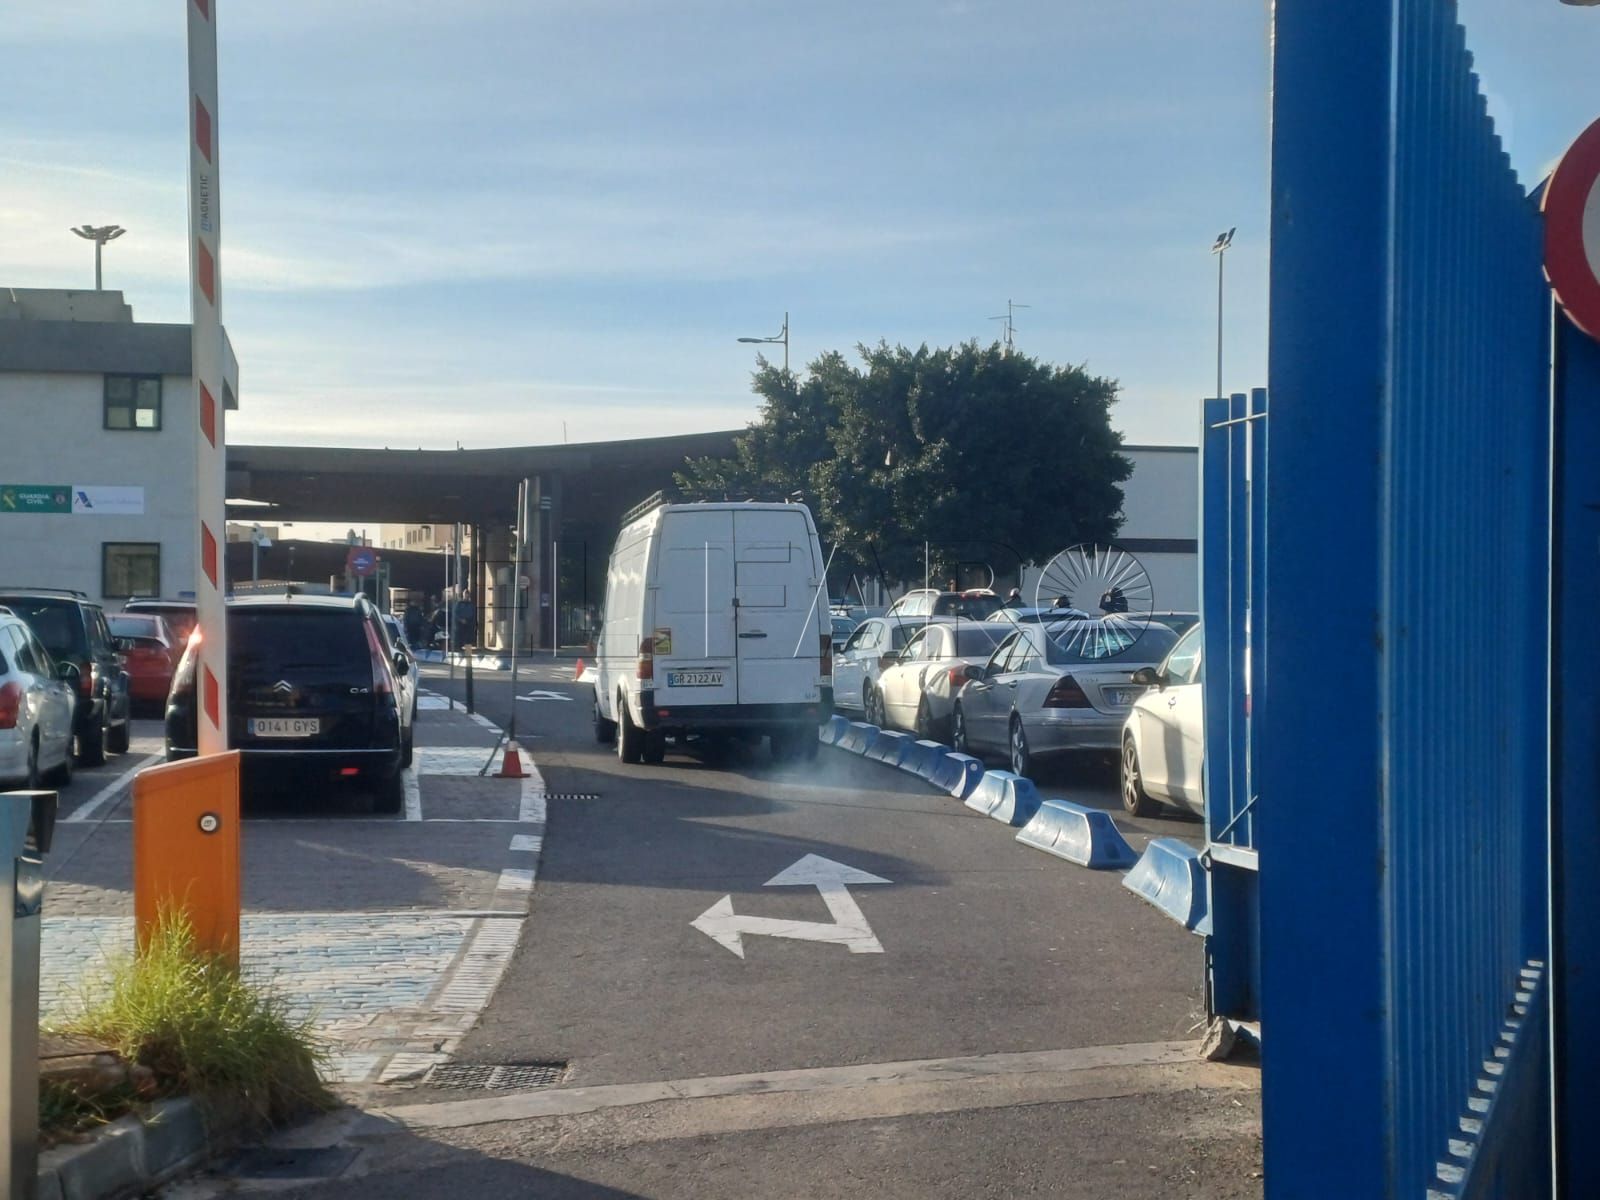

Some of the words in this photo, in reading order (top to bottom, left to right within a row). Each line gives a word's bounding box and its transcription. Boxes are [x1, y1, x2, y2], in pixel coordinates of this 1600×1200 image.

[673, 673, 685, 684] GR
[687, 673, 710, 684] 2122
[711, 672, 723, 683] AV
[257, 720, 289, 732] 0141
[294, 720, 319, 732] GYS
